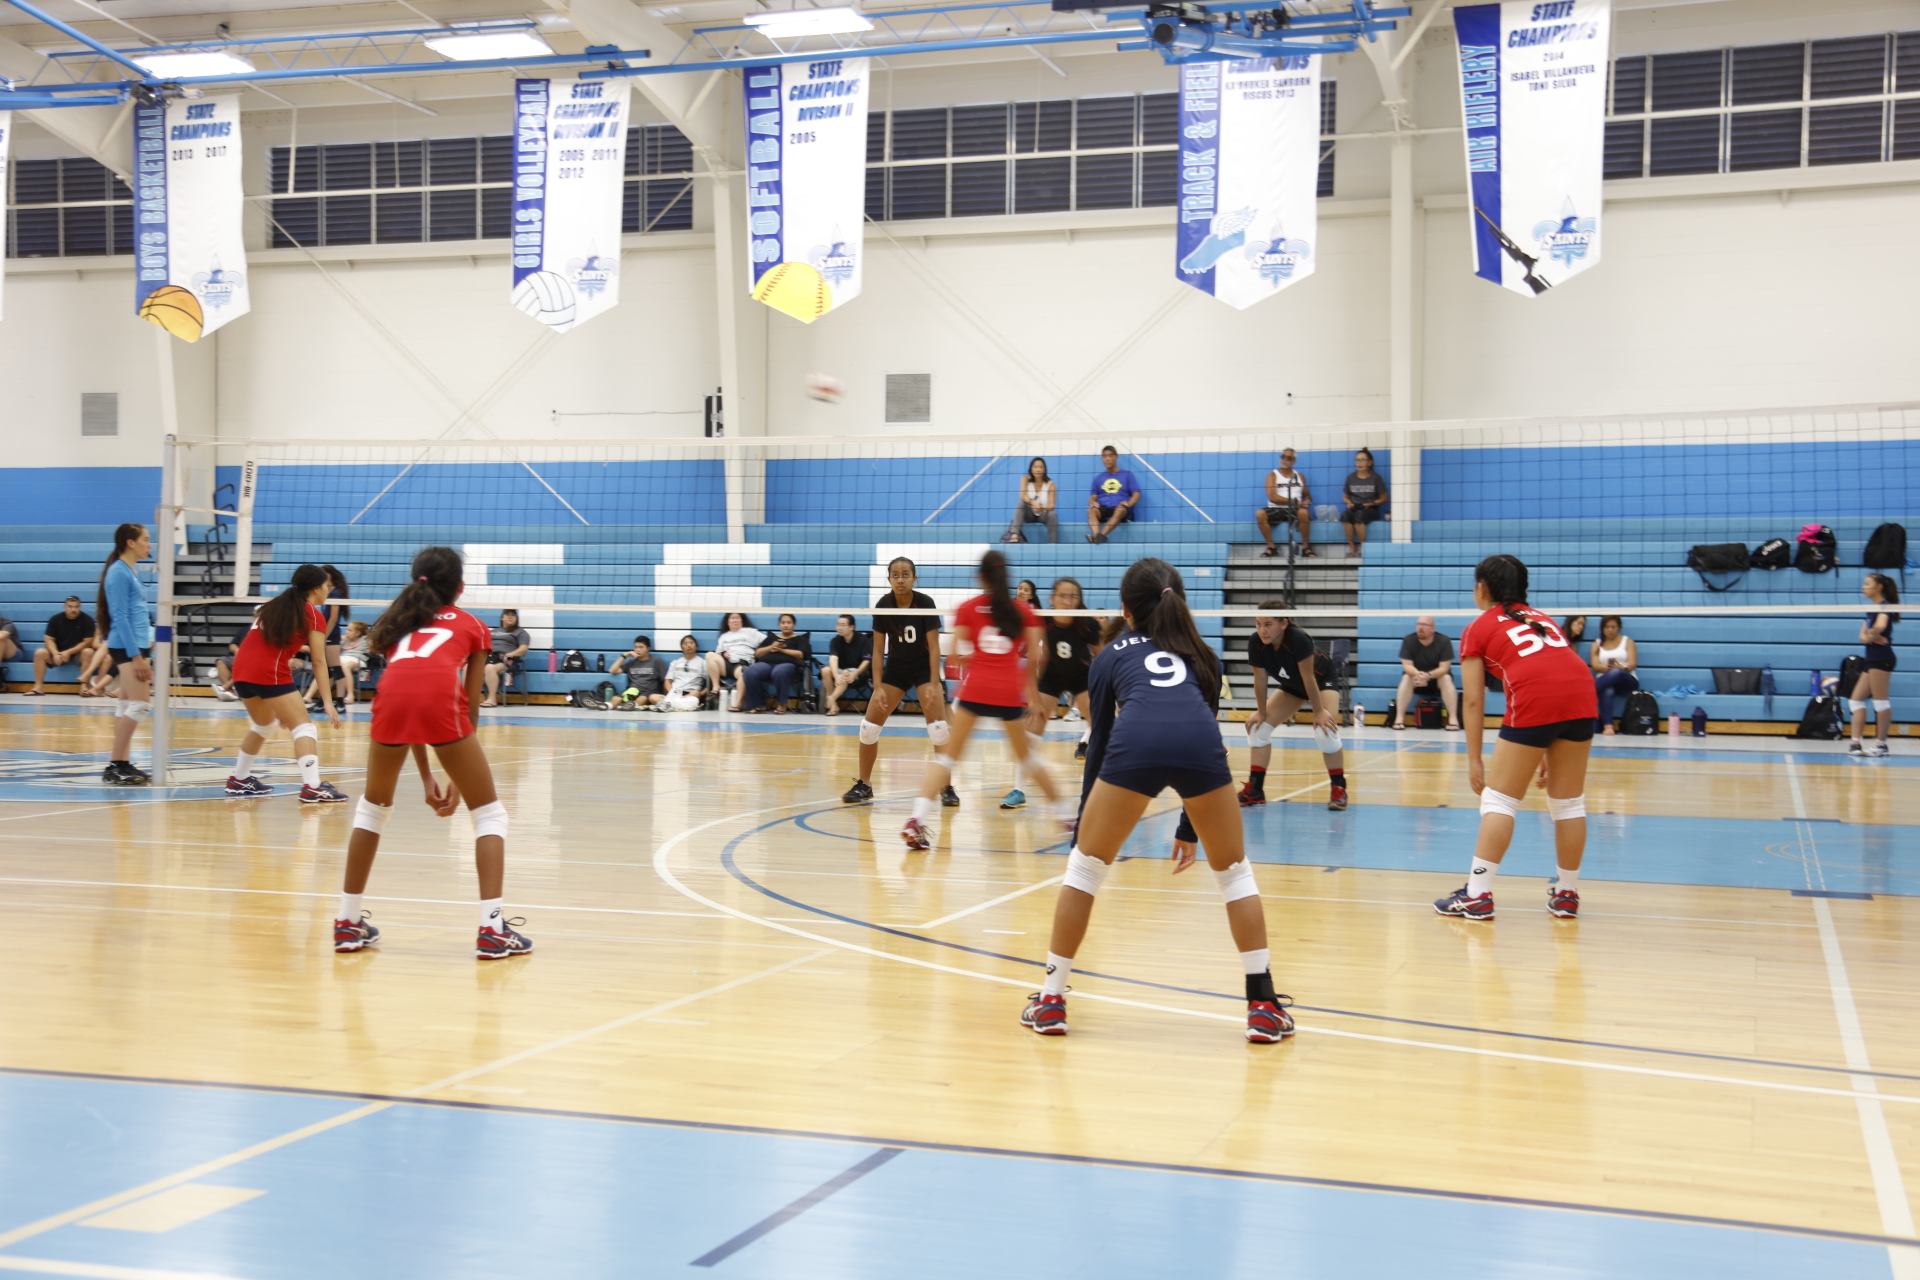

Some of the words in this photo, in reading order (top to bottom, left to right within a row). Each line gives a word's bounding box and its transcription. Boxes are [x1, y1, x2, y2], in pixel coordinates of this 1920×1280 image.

[1530, 0, 1576, 22] STATE
[1508, 21, 1599, 48] CHAMPIONS
[808, 60, 843, 79] STATE
[1227, 54, 1311, 74] CHAMPONS
[1511, 70, 1540, 82] ISABEL
[1544, 64, 1595, 79] VILLANUEVA
[571, 81, 605, 99] STATE
[789, 79, 860, 101] CHAMPIONS
[1184, 62, 1220, 111] FIEL
[1460, 45, 1497, 128] RIFLERY
[1529, 82, 1549, 92] TONI
[1553, 78, 1576, 89] SILVA
[186, 103, 217, 120] STATE
[553, 101, 621, 119] CHAMPIONS
[797, 104, 842, 121] DIVISION
[171, 121, 232, 141] CHAMPIONS
[553, 122, 606, 139] DIVISION
[790, 131, 816, 144] 2005
[1183, 120, 1217, 139] &
[516, 81, 547, 202] VOLLEYBALL
[559, 149, 584, 161] 2005
[592, 148, 617, 160] 2011
[1468, 135, 1497, 172] AIR
[138, 105, 166, 225] BASKETBALL
[558, 167, 584, 179] 2012
[750, 67, 780, 263] SOFTBALL
[1182, 148, 1217, 223] TRACK
[513, 208, 543, 269] GIRLS
[140, 231, 168, 281] BOYS
[389, 627, 454, 663] 17
[1506, 621, 1568, 657] 50
[1056, 641, 1072, 659] 8
[1144, 651, 1187, 687] 9
